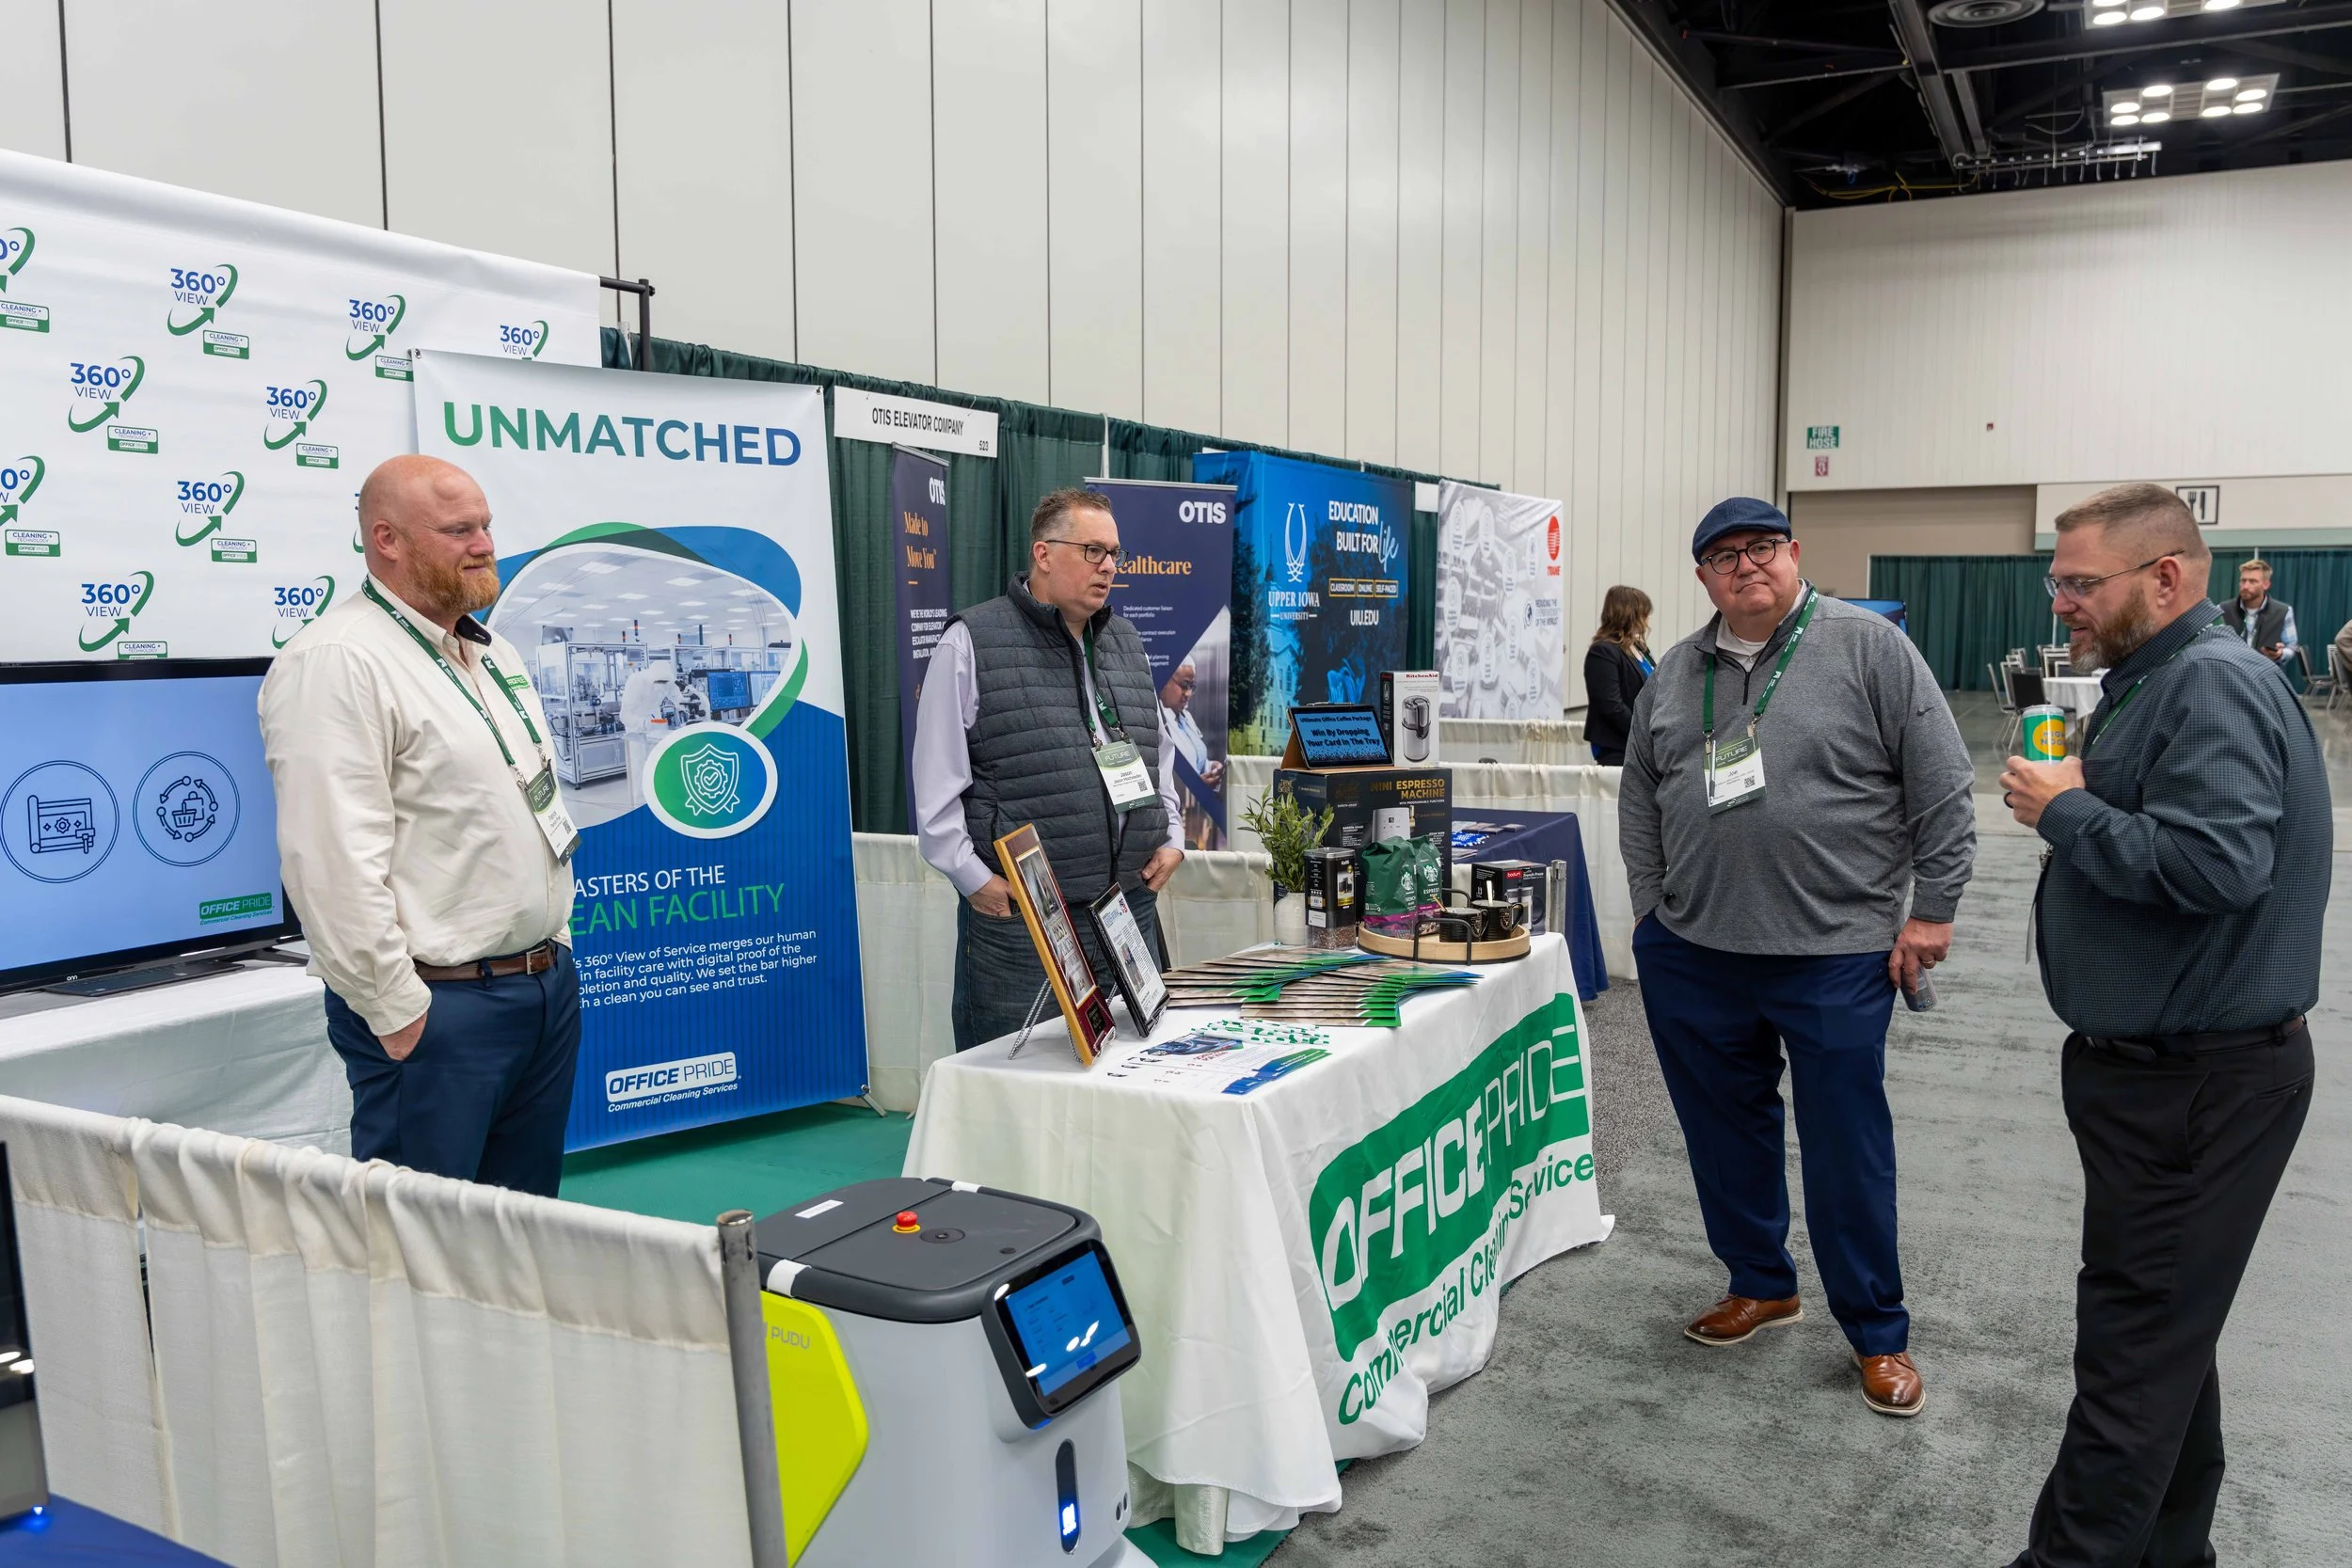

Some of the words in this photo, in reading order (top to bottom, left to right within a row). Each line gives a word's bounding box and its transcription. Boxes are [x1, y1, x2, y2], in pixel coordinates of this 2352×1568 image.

[170, 268, 225, 293] 360°
[1, 303, 36, 313] CLEANING
[175, 291, 208, 306] VIEW
[349, 299, 395, 322] 360°
[352, 320, 380, 333] VIEW
[500, 325, 539, 345] 360°
[210, 333, 238, 342] CLEANING
[502, 344, 527, 356] VIEW
[71, 363, 131, 388] 360°
[75, 386, 112, 400] VIEW
[266, 387, 316, 409] 360°
[270, 407, 300, 420] VIEW
[872, 407, 892, 426] OTIS
[894, 410, 932, 432] ELEVATOR
[934, 416, 964, 436] COMPANY
[114, 428, 146, 436] CLEANING
[443, 402, 802, 467] UNMATCHED
[1813, 427, 1834, 437] FIRE
[978, 440, 989, 451] 523
[1809, 437, 1836, 449] HOSE
[178, 481, 232, 502] 360°
[929, 477, 946, 506] OTIS
[182, 503, 215, 515] VIEW
[1179, 500, 1227, 524] OTIS
[1328, 500, 1379, 526] EDUCATION
[904, 511, 921, 535] Made
[921, 516, 929, 537] to
[1336, 531, 1360, 552] BUILT
[1361, 533, 1378, 554] FOR
[906, 545, 922, 567] Move
[1114, 556, 1192, 576] ealthcare
[1547, 565, 1561, 576] TRANE
[82, 584, 140, 604] 360°
[274, 587, 324, 606] 360°
[1330, 583, 1355, 592] CLASSROOM
[1358, 583, 1373, 593] ONLINE
[1375, 584, 1396, 594] SELF-PACED
[1268, 591, 1296, 607] UPPER
[1297, 592, 1320, 608] IOWA
[86, 607, 122, 617] VIEW
[278, 608, 308, 617] VIEW
[1279, 611, 1309, 620] UNIVERSITY
[1350, 610, 1379, 626] UIU.EDU
[1326, 729, 1336, 737] By
[1336, 727, 1370, 736] Dropping
[1364, 737, 1380, 746] Tray
[1105, 751, 1131, 761] FUTURE
[1716, 745, 1748, 763] FUTURE
[534, 784, 550, 802] FUTURE
[1370, 782, 1392, 791] MINI
[1396, 778, 1445, 790] ESPRESSO
[1401, 788, 1445, 800] MACHINE
[655, 868, 682, 890] OF
[686, 865, 725, 887] THE
[200, 900, 240, 916] OFFICE
[242, 895, 271, 909] PRIDE
[649, 883, 785, 927] FACILITY
[200, 915, 230, 926] Commercial
[230, 912, 251, 921] Cleaning
[615, 951, 645, 962] View
[649, 947, 661, 958] of
[663, 943, 706, 957] Service
[709, 939, 753, 951] merges
[755, 936, 774, 945] our
[777, 930, 817, 942] human
[580, 971, 591, 981] in
[595, 966, 635, 979] facility
[638, 962, 664, 974] care
[667, 958, 694, 970] with
[697, 951, 733, 967] digital
[737, 947, 767, 962] proof
[769, 945, 781, 956] of
[783, 944, 801, 955] the
[624, 976, 647, 989] and
[650, 972, 693, 987] quality.
[696, 969, 715, 979] We
[718, 965, 736, 976] set
[739, 962, 757, 974] the
[760, 960, 779, 971] bar
[782, 955, 818, 968] higher
[594, 998, 600, 1006] a
[604, 993, 637, 1006] clean
[640, 990, 662, 1003] you
[665, 985, 687, 996] can
[690, 983, 709, 993] see
[712, 977, 735, 990] and
[738, 974, 768, 987] trust.
[609, 1068, 679, 1095] OFFICE
[684, 1058, 734, 1082] PRIDE
[608, 1098, 660, 1113] Commercial
[662, 1089, 701, 1102] Cleaning
[703, 1083, 739, 1096] Services
[1322, 1096, 1485, 1311] OFFICE
[771, 1324, 810, 1349] PUDU
